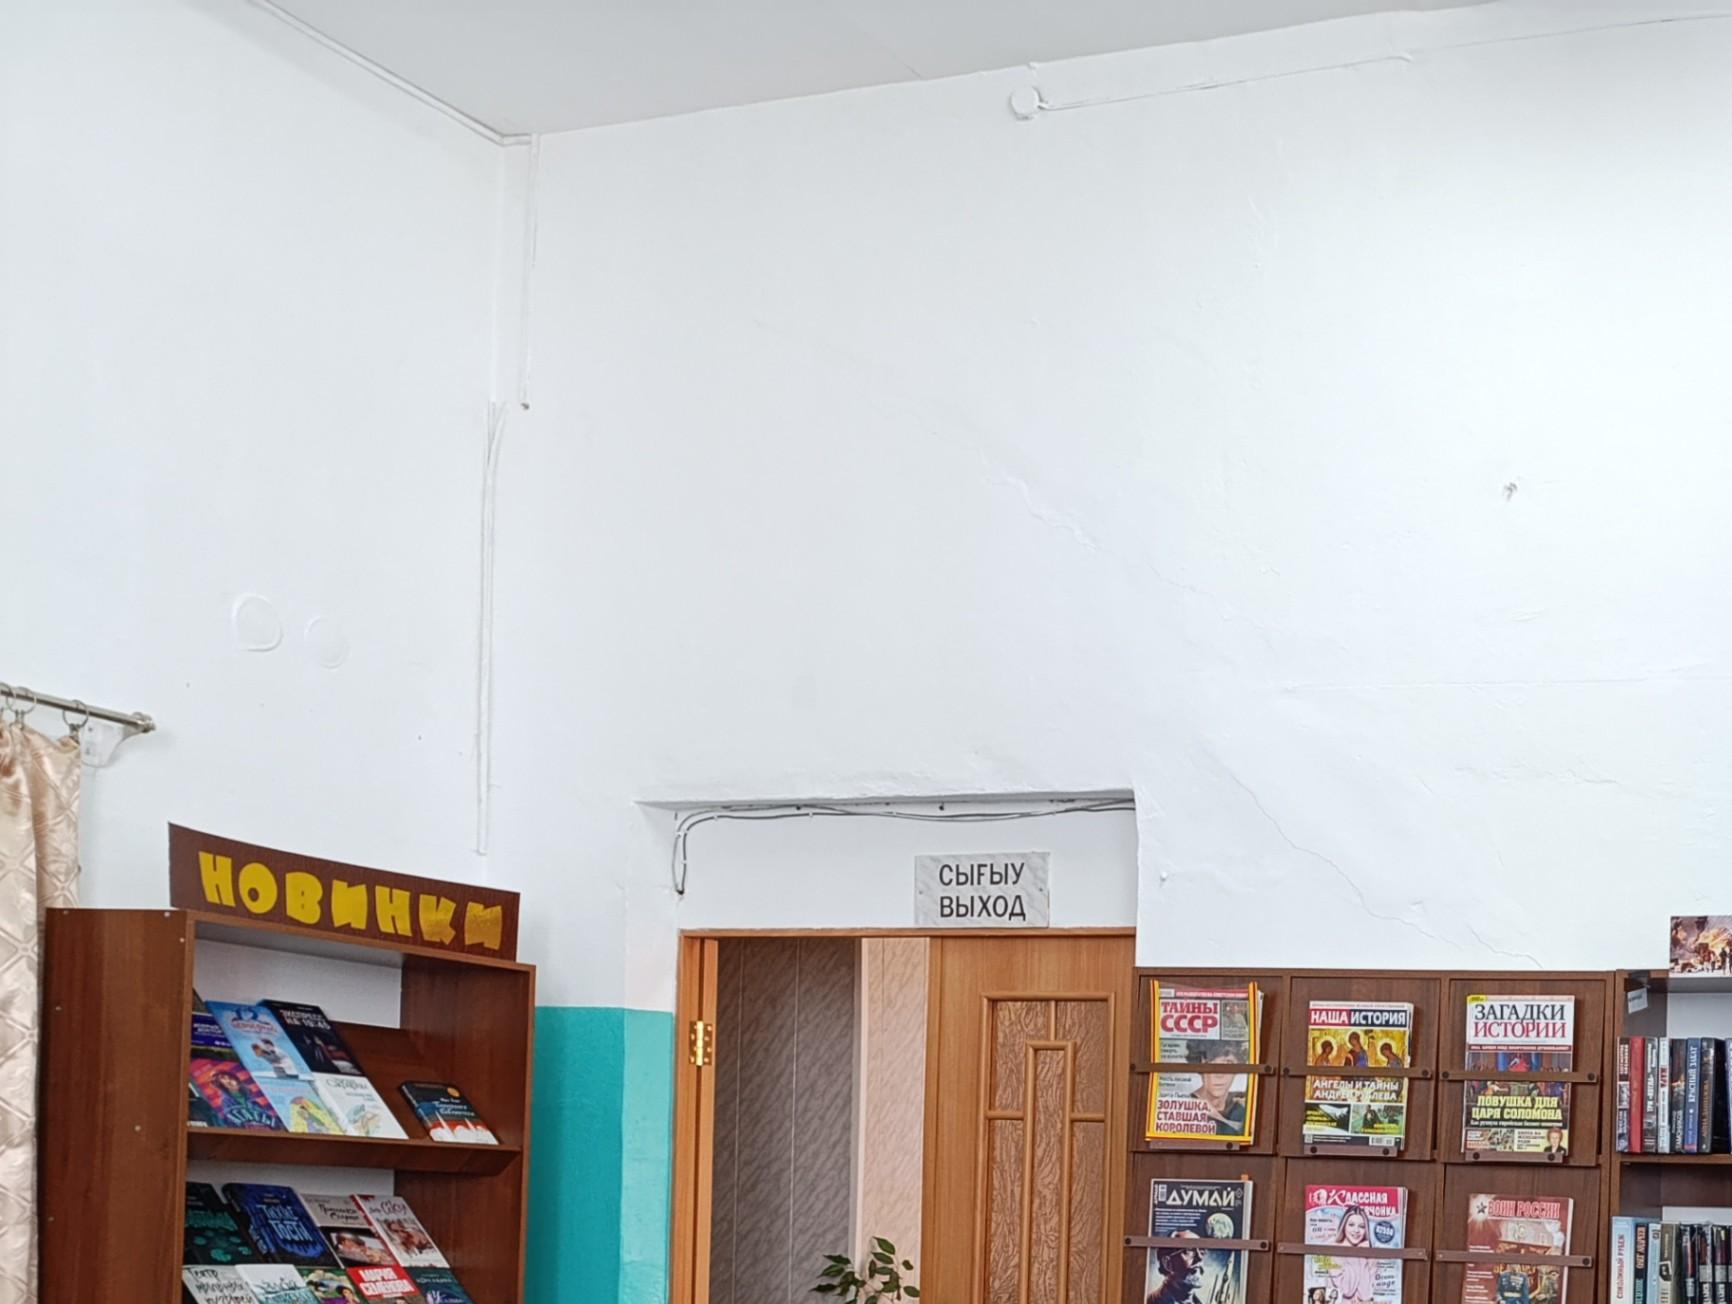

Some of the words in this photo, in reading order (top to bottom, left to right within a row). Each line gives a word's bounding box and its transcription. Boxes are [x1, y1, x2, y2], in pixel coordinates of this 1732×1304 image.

[198, 851, 503, 949] НОВИНКИ
[939, 895, 1026, 921] ВЫХОД
[1161, 1000, 1219, 1014] ТАЙНЫ
[1474, 1004, 1566, 1021] ЗАГАДКИ
[1161, 1015, 1218, 1033] СССР
[1311, 1010, 1349, 1024] НАША
[1351, 1011, 1406, 1025] ИСТОРИЯ
[1473, 1022, 1567, 1038] ИСТОРИИ
[1166, 1187, 1235, 1206] ДУМАЙ
